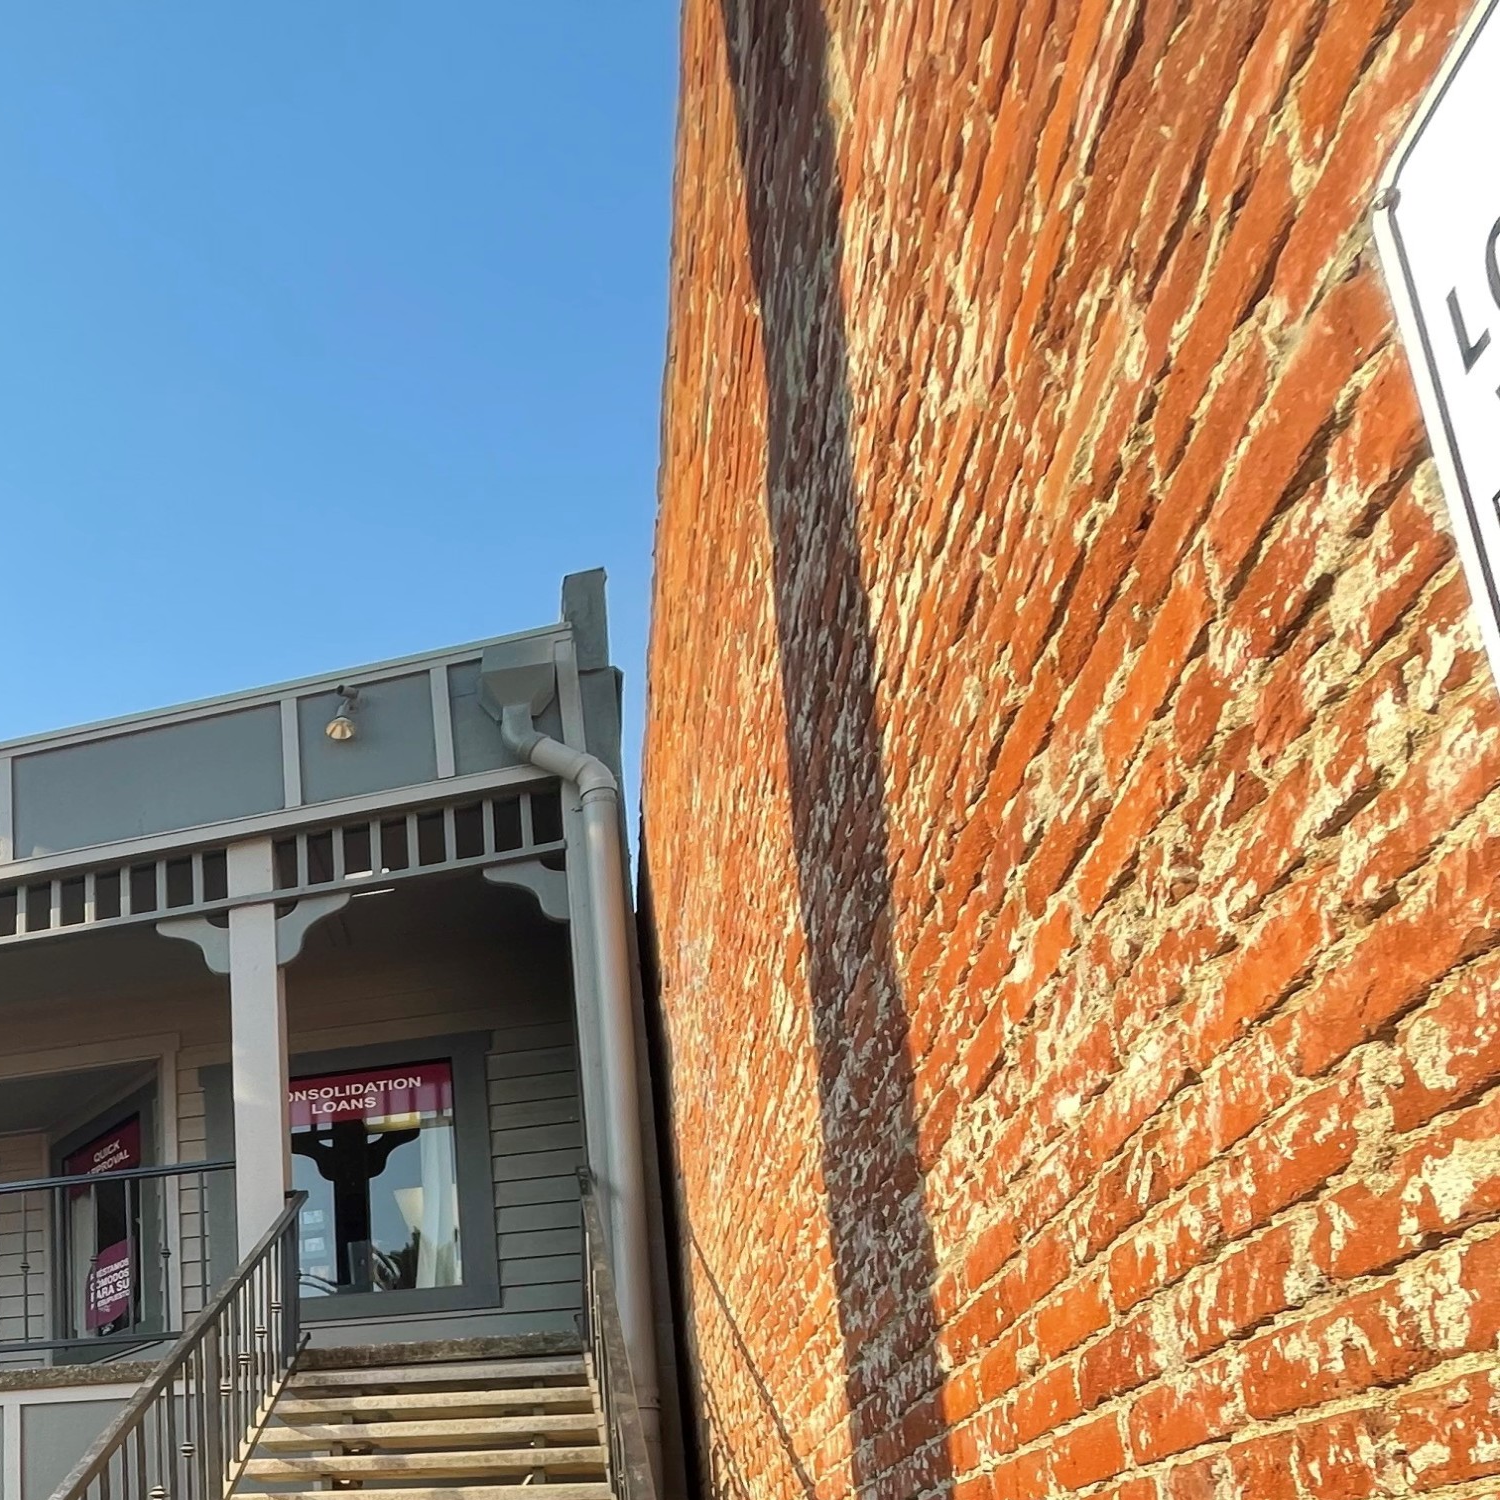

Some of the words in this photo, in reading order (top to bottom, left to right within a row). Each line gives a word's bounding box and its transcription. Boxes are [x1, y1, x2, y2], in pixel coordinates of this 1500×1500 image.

[289, 1077, 421, 1102] NSOLIDATION
[312, 1097, 376, 1115] LOANS
[93, 1139, 120, 1162] QUICK
[116, 1277, 130, 1292] SU
